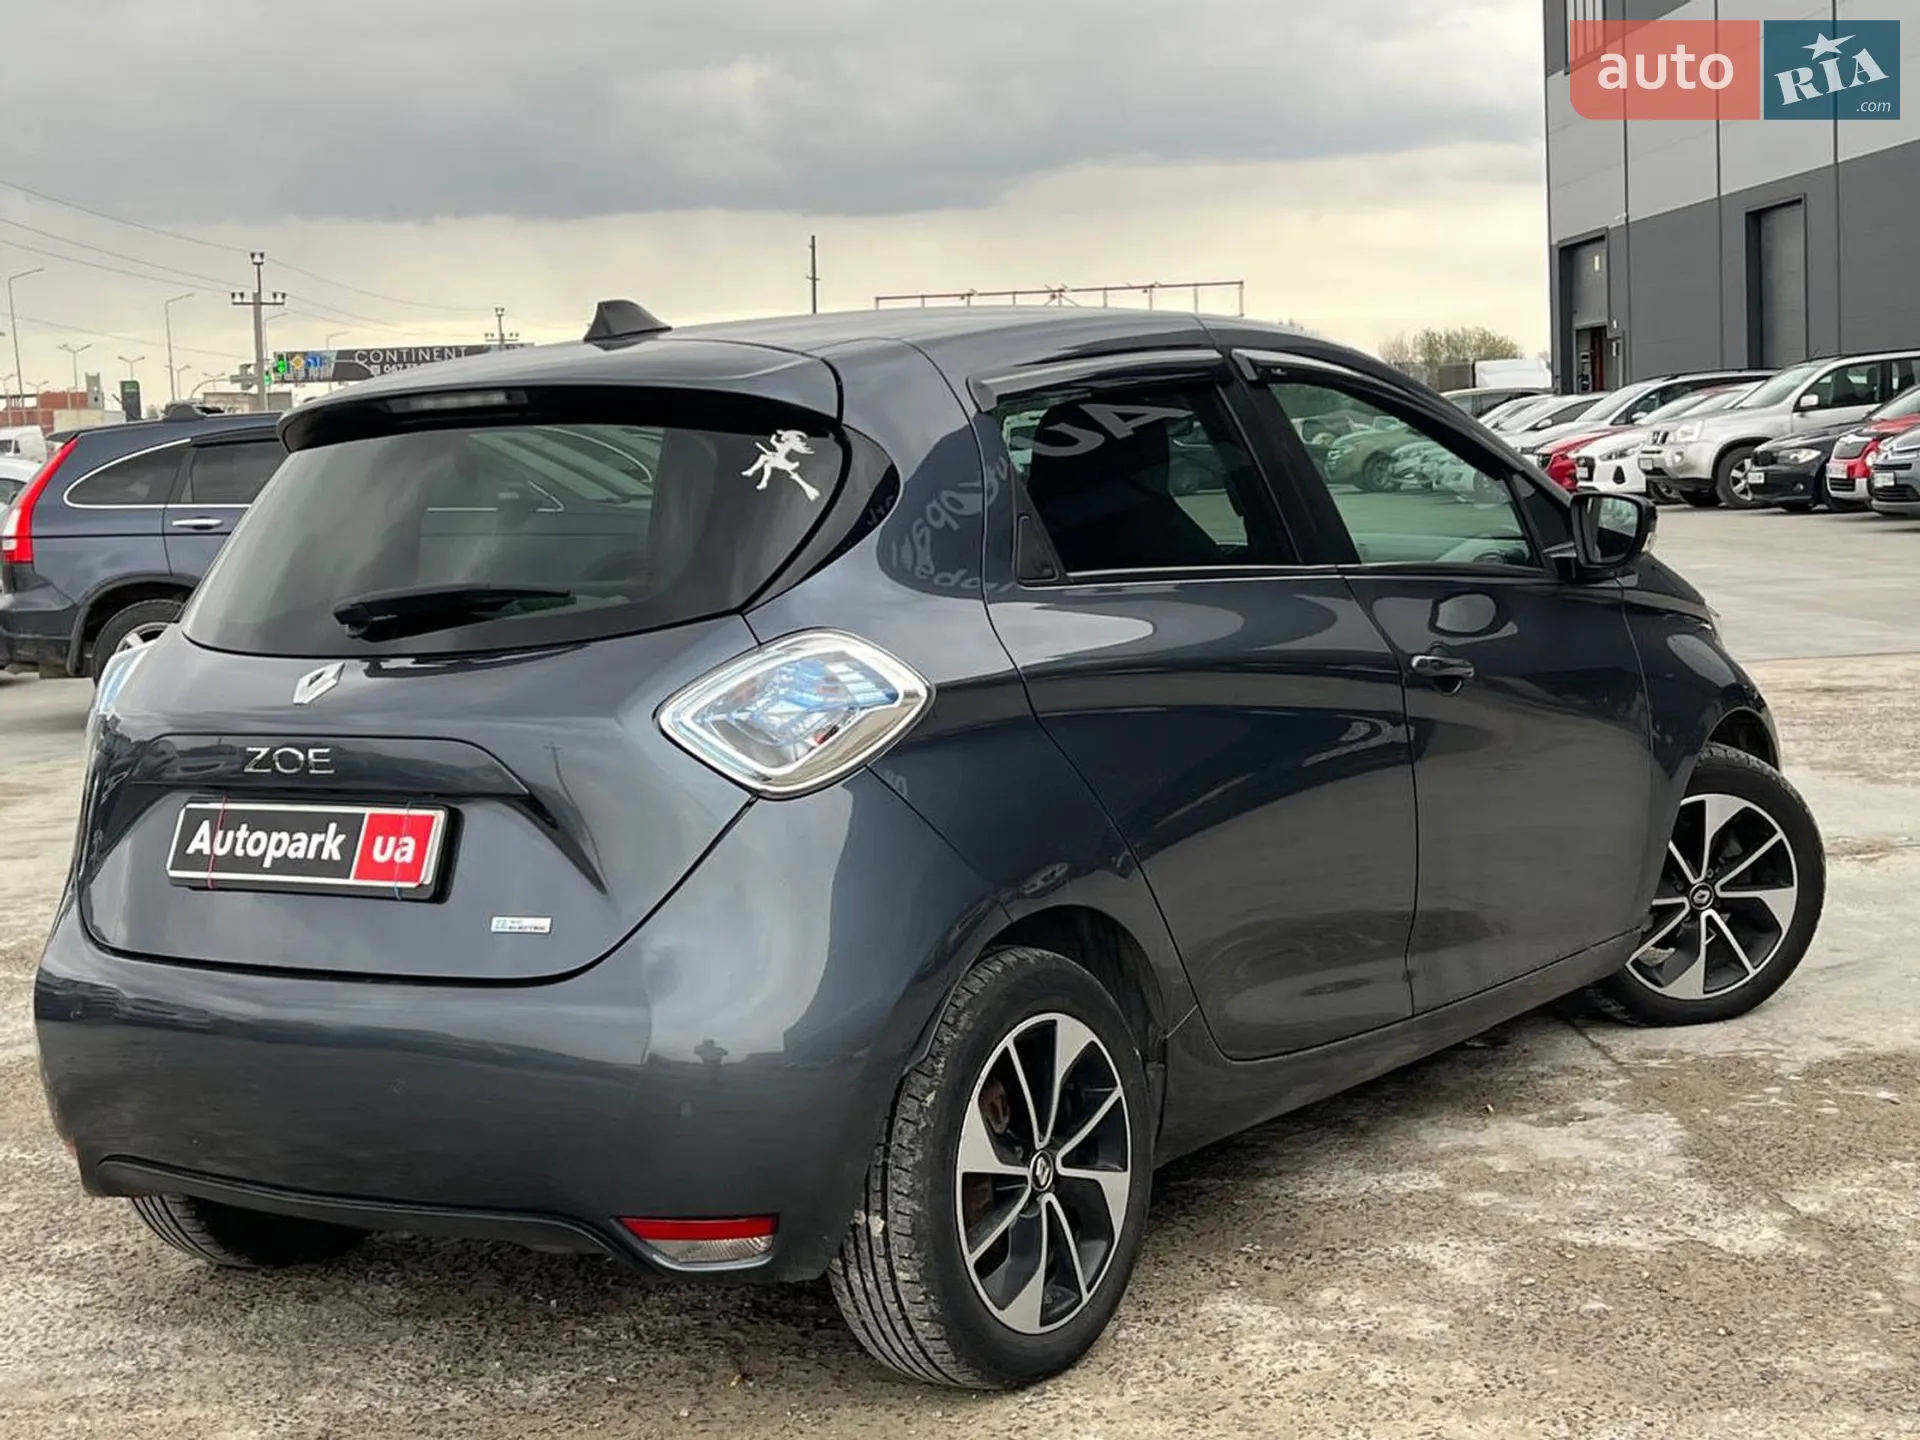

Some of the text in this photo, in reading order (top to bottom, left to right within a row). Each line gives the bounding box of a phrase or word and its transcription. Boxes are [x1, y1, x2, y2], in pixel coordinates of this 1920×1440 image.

[354, 346, 468, 364] CONTINENT
[243, 746, 335, 774] ZOE
[186, 819, 416, 869] Autopark ua
